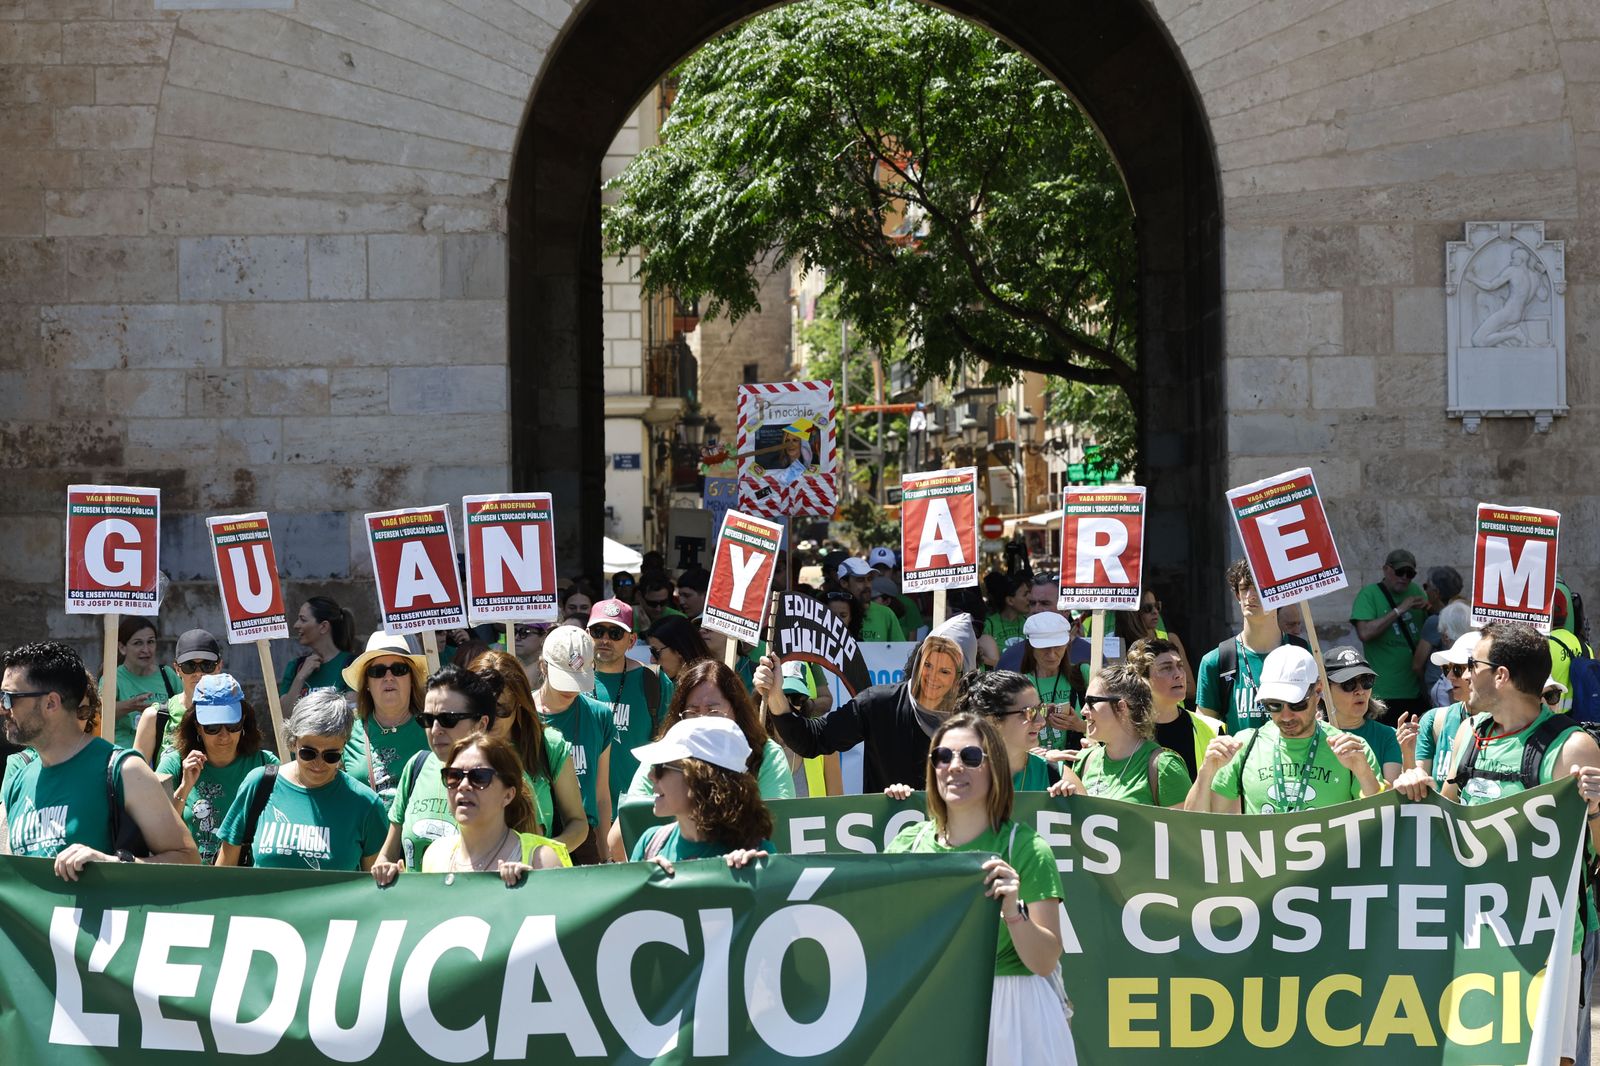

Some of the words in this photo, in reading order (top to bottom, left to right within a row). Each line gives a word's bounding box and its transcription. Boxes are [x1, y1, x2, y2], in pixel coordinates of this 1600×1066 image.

[1239, 504, 1264, 516] DEFENSEM
[1265, 494, 1291, 508] L'EDUCACIÓ
[1292, 488, 1312, 500] PÚBLICA
[1248, 493, 1263, 502] VAGA
[1264, 482, 1296, 496] INDEFINIDA
[73, 506, 100, 514] DEFENSEM
[101, 506, 131, 514] L'EDUCACIÓ
[132, 506, 154, 515] PÚBLICA
[381, 518, 398, 526] VAGA
[399, 514, 433, 524] INDEFINIDA
[470, 514, 496, 522] DEFENSEM
[498, 512, 526, 520] L'EDUCACIÓ
[527, 511, 548, 520] PÚBLICA
[1092, 504, 1118, 512] L'EDUCACIÓ
[1120, 504, 1140, 512] PÚBLICA
[375, 530, 400, 539] DEFENSEM
[400, 526, 425, 536] L'EDUCACIÓ
[426, 524, 444, 534] PÚBLICA
[914, 498, 965, 569] A
[1255, 504, 1322, 582] E
[84, 518, 142, 588] G
[482, 524, 542, 594] N
[1075, 518, 1130, 584] R
[228, 544, 272, 614] U
[394, 540, 450, 608] A
[728, 544, 767, 612] Y
[952, 574, 974, 582] RIBERA
[957, 566, 974, 574] PÚBLIC
[1264, 588, 1276, 596] SOS
[1277, 575, 1318, 592] ENSENYAMENT
[1318, 568, 1339, 580] PÚBLIC
[1482, 536, 1548, 610] M
[86, 591, 130, 599] ENSENYAMENT
[132, 591, 154, 600] PÚBLIC
[489, 596, 531, 604] ENSENYAMENT
[532, 594, 552, 602] PÚBLIC
[1117, 587, 1137, 595] PÚBLIC
[1282, 588, 1303, 598] JOSEP
[1316, 576, 1340, 588] RIBERA
[389, 614, 400, 622] SOS
[401, 610, 440, 620] ENSENYAMENT
[440, 606, 460, 616] PÚBLIC
[404, 620, 426, 628] JOSEP
[438, 616, 460, 624] RIBERA
[1530, 613, 1548, 622] PÚBLIC
[780, 620, 844, 672] PÚBLICA
[1436, 750, 1452, 778] LA
[40, 838, 66, 848] TOCA
[260, 822, 276, 848] LA
[276, 822, 331, 854] LLENGUA
[789, 810, 1122, 875] ESES
[1154, 820, 1170, 880] I
[1200, 794, 1562, 884] INSTITUTS
[297, 850, 330, 860] TOCA
[1121, 875, 1562, 954] COSTERA
[48, 866, 868, 1064] L'EDUCACIÓ
